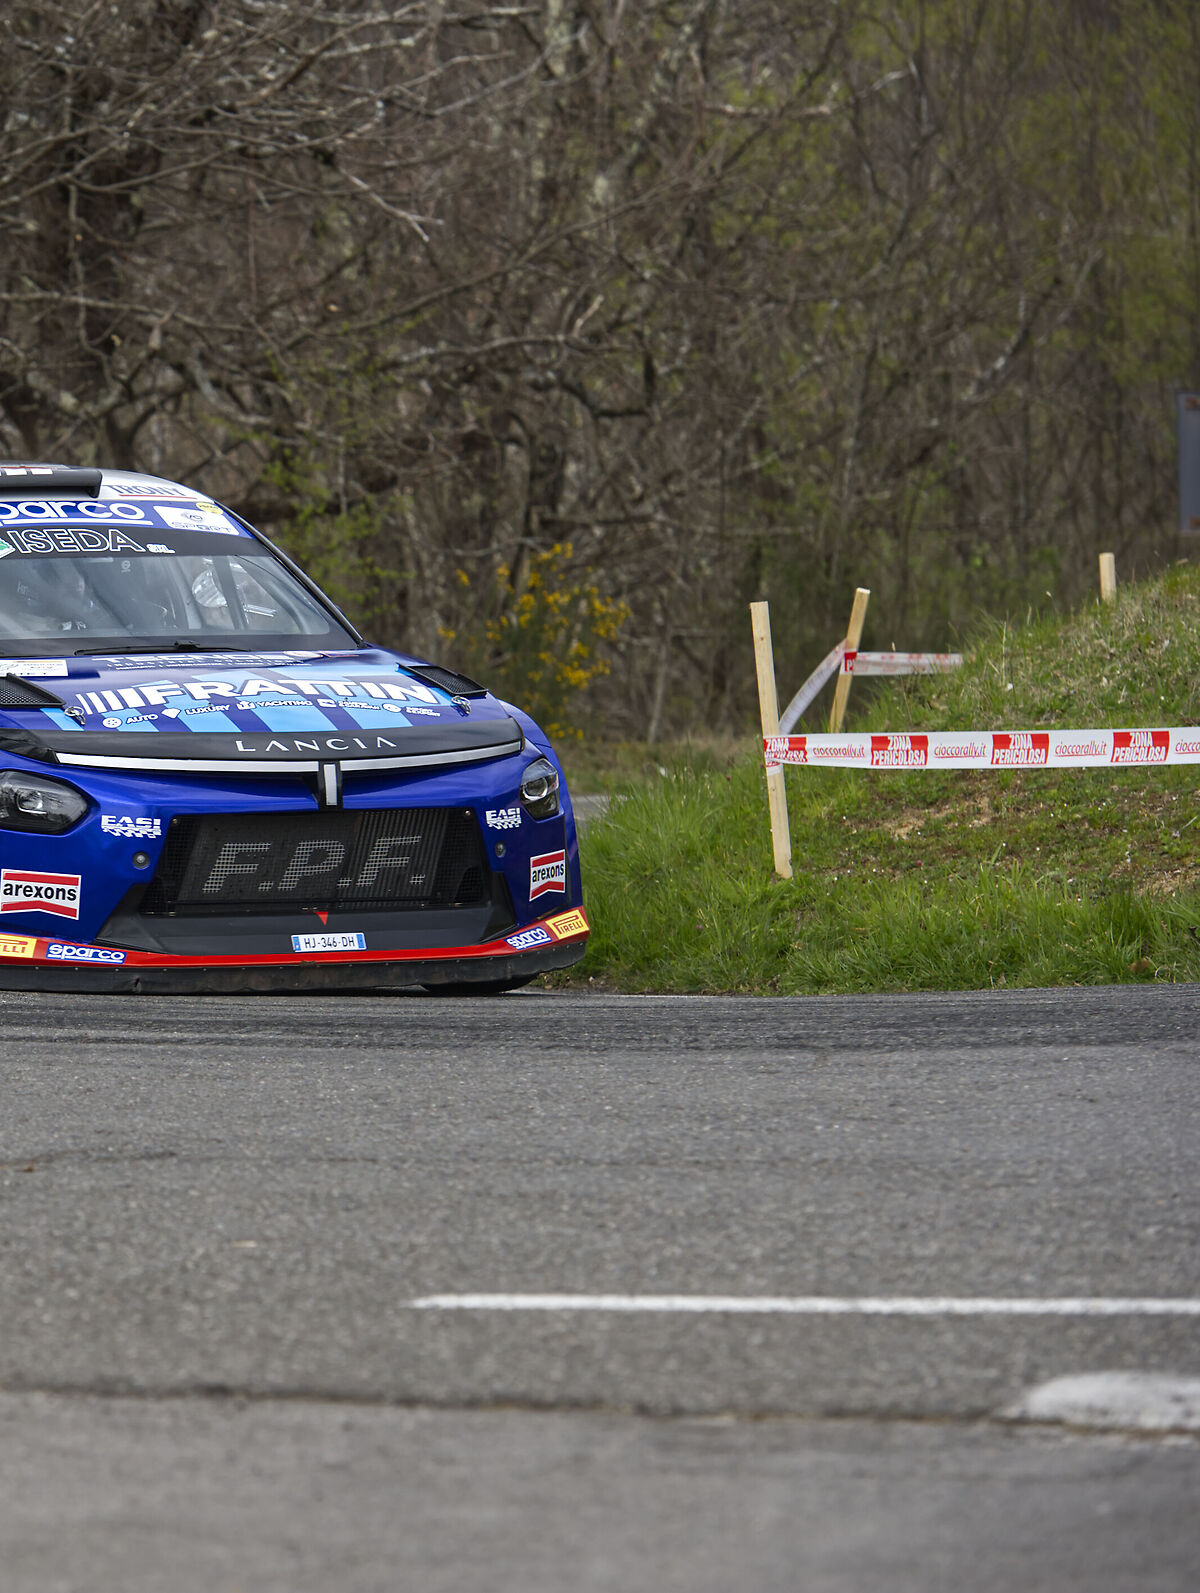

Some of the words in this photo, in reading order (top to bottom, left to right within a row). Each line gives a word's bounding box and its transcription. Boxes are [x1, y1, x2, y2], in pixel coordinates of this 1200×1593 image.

[102, 484, 186, 497] TRONY
[171, 521, 232, 533] SPORT
[6, 528, 146, 553] ISEDA
[126, 713, 158, 724] AUTO
[186, 703, 230, 715] LUXURY
[257, 699, 313, 708] YACHTING
[235, 736, 397, 752] LANCIA
[766, 738, 789, 751] ZONA
[888, 736, 912, 750] ZONA
[1009, 734, 1033, 749] ZONA
[1129, 732, 1153, 747] ZONA
[813, 744, 865, 758] cioccorally.it
[934, 742, 987, 758] cioccorally.it
[1054, 740, 1107, 756] cioccorally.it
[1112, 746, 1166, 762] PERICOLOSA
[873, 750, 926, 765] PERICOLOSA
[993, 749, 1046, 764] PERICOLOSA
[202, 836, 425, 893] F.P.F.
[532, 863, 564, 883] arexons
[3, 882, 77, 902] arexons
[553, 914, 584, 934] PIRELLI
[304, 936, 355, 949] HJ-346-DH
[506, 927, 548, 948] sparco
[49, 943, 125, 960] sparco
